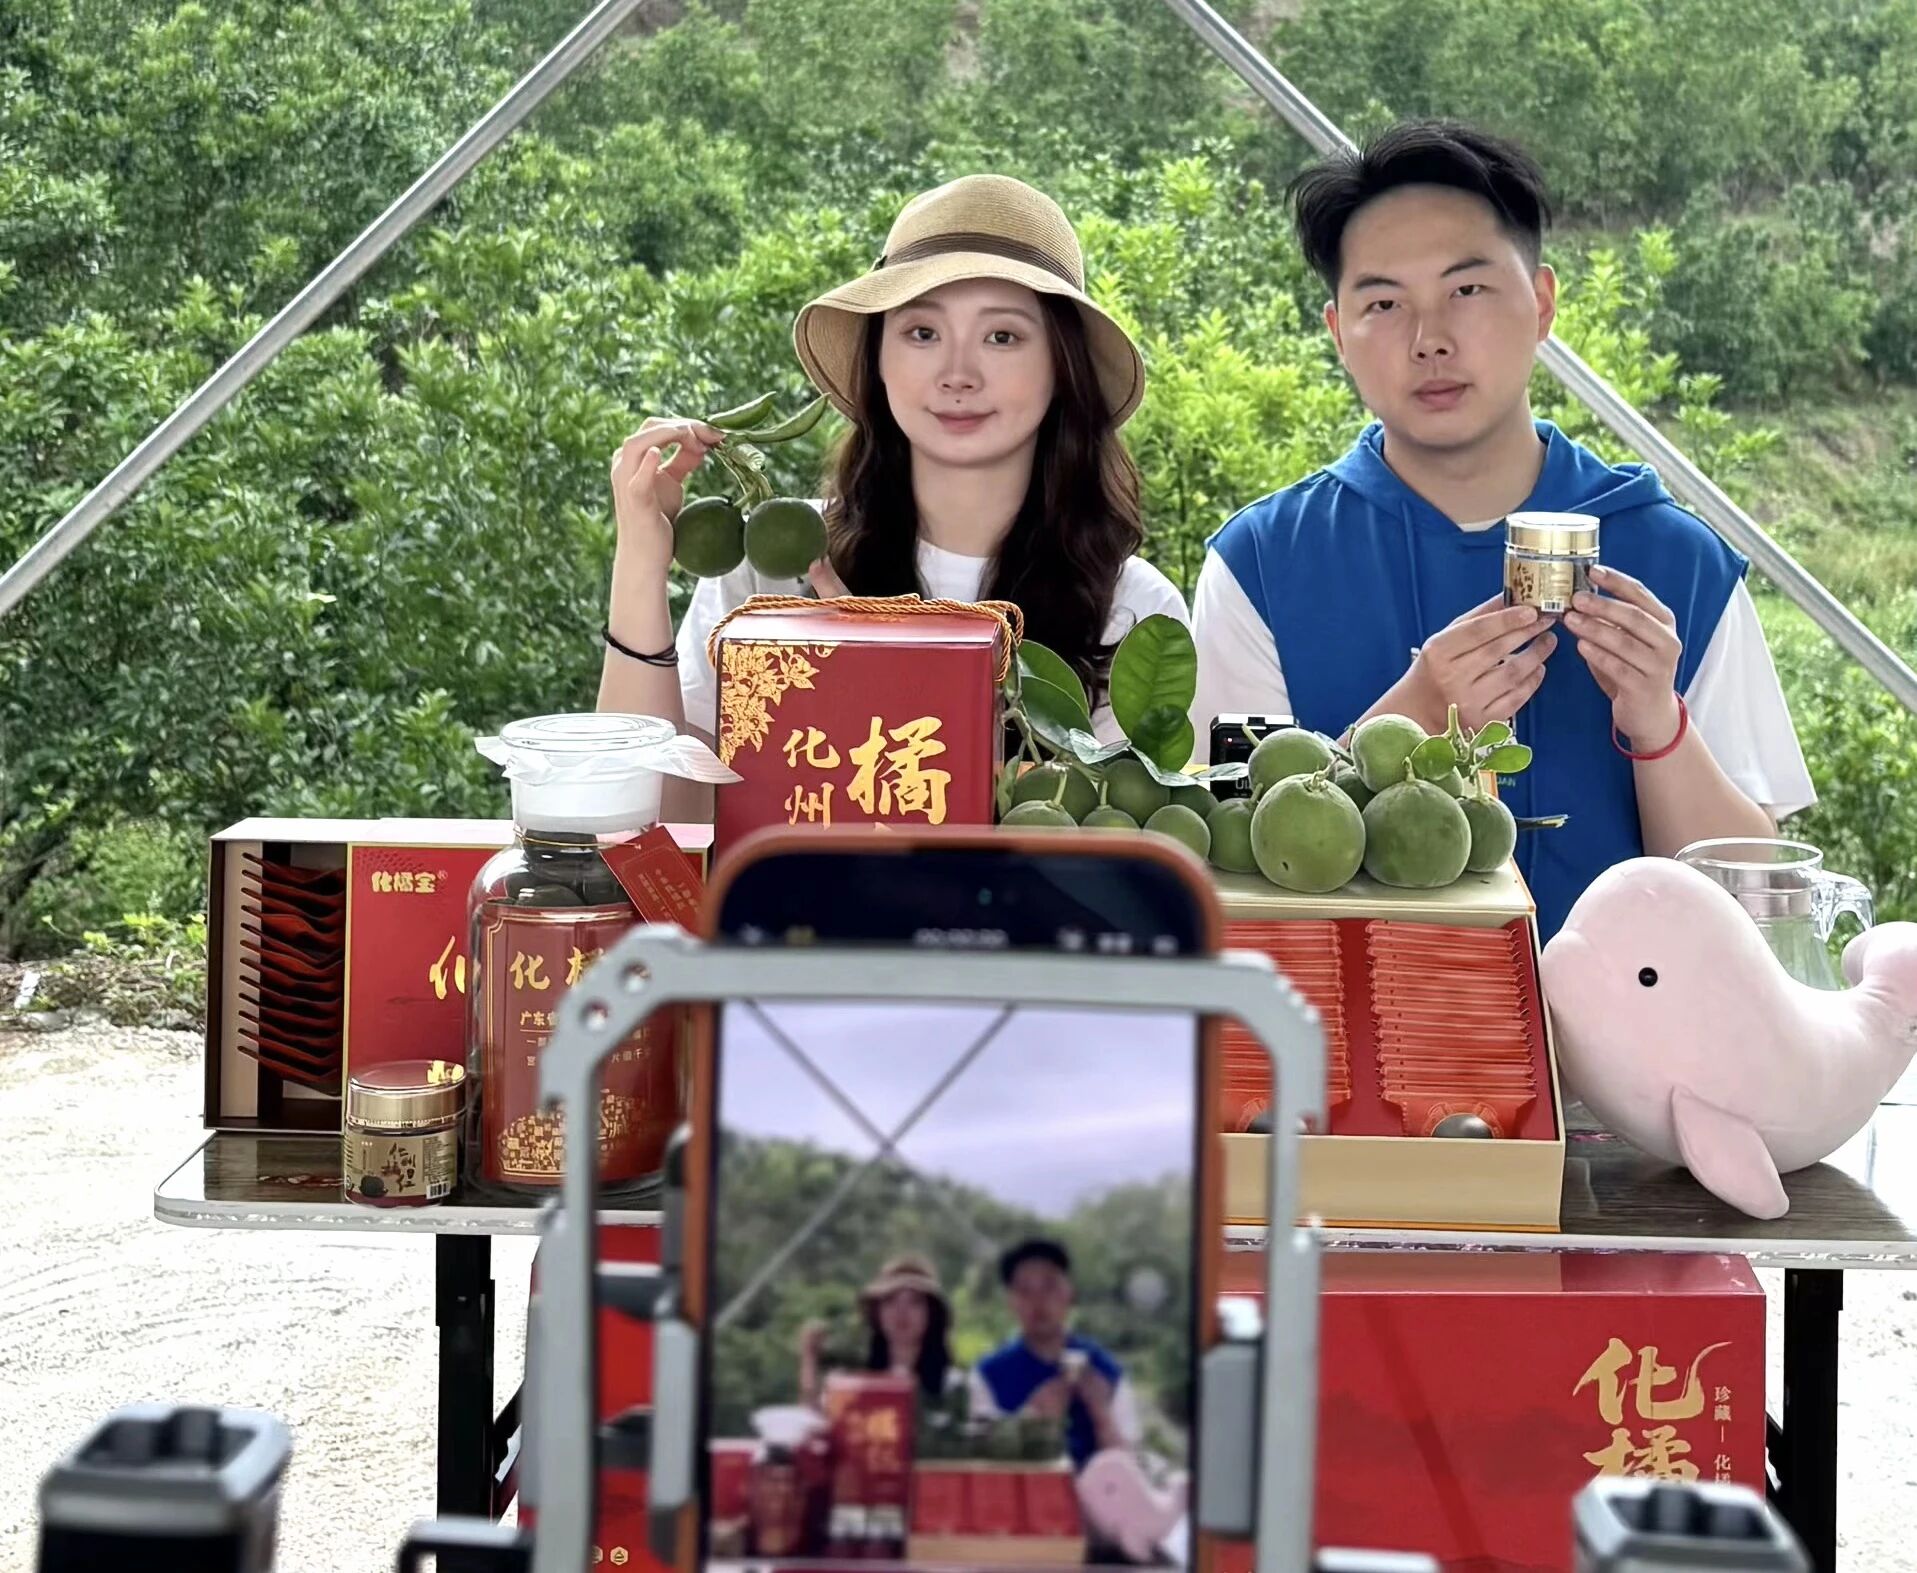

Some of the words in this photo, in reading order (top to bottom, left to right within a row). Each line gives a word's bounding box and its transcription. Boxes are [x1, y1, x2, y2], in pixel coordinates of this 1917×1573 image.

[782, 726, 841, 831] 化州
[846, 716, 951, 831] 橘
[371, 870, 437, 894] 化橘宝
